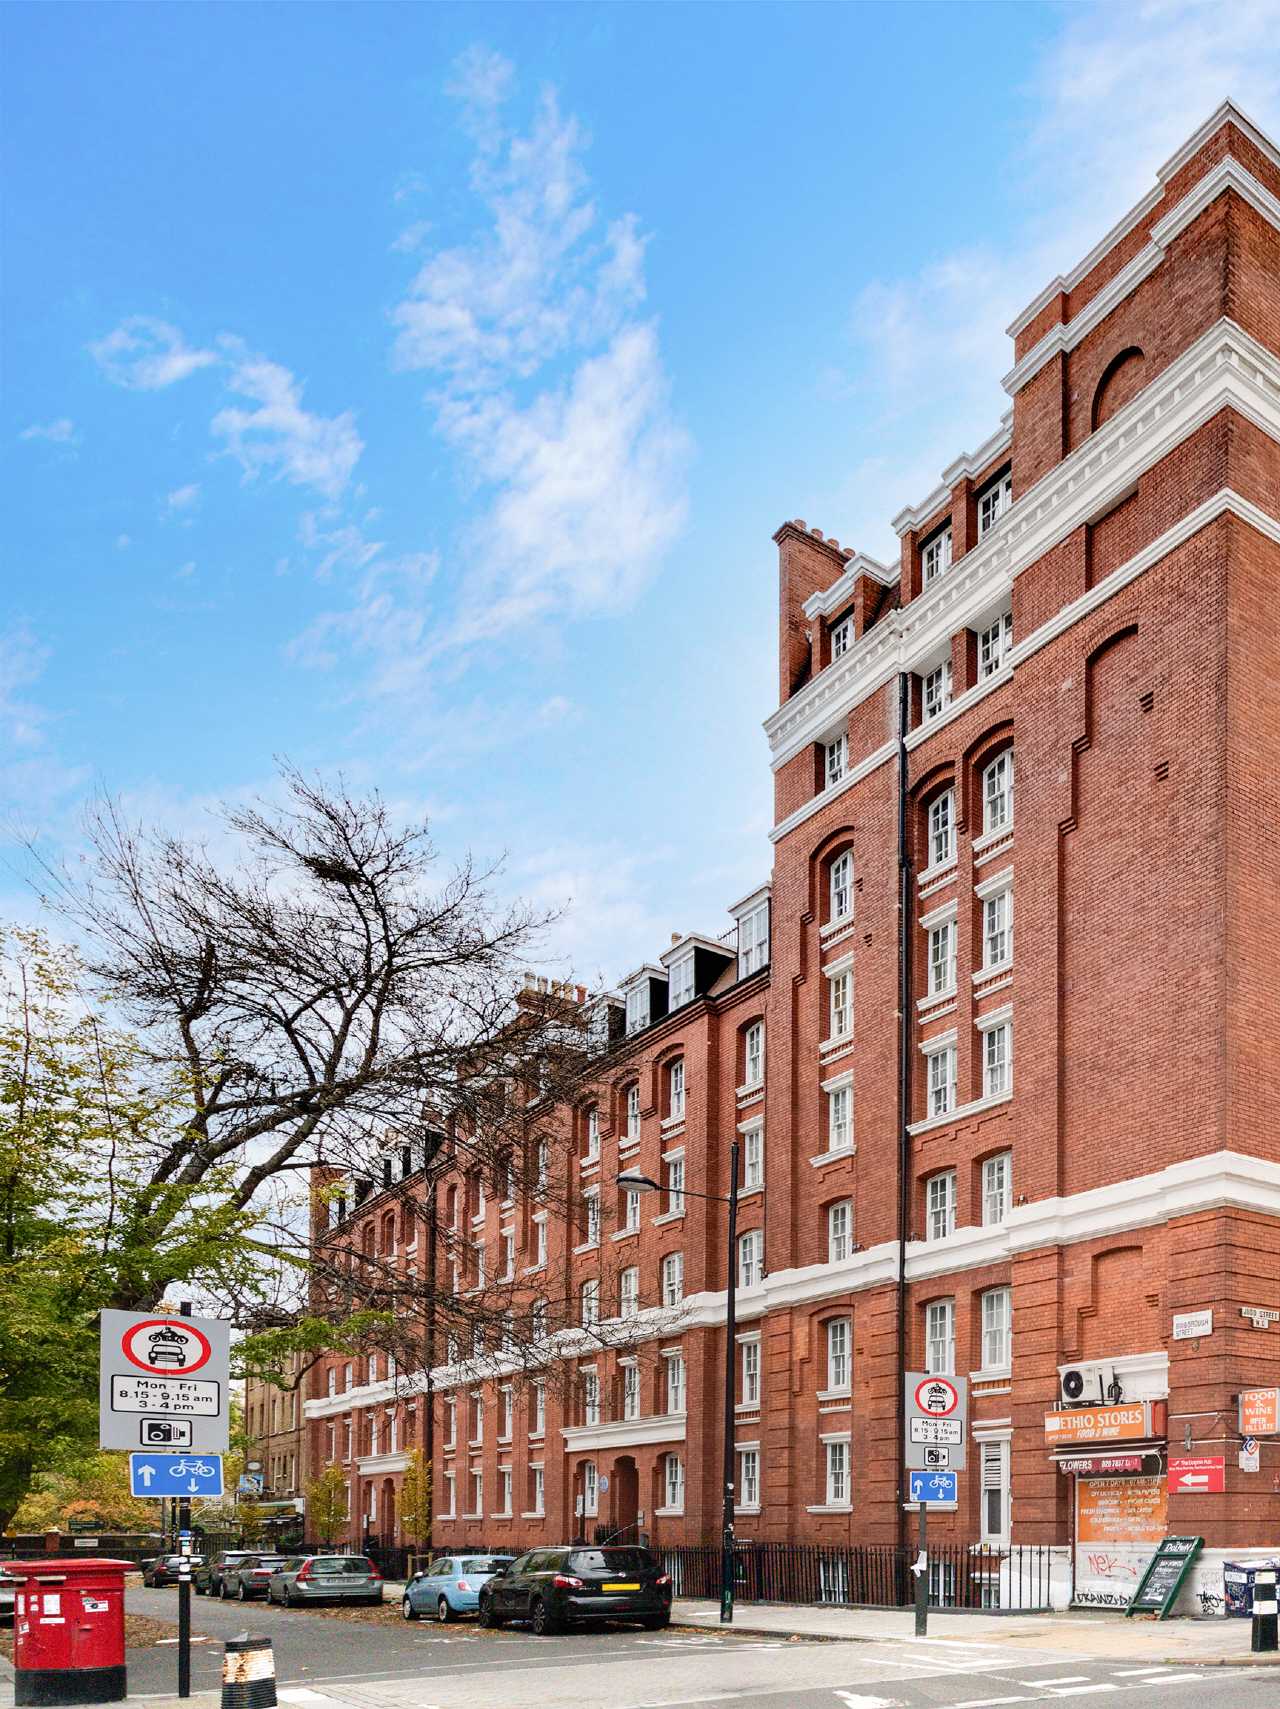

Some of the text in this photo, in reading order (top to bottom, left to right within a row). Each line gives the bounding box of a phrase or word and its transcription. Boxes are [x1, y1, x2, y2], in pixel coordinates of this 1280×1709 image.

[1259, 1310, 1278, 1320] STREET
[1175, 1328, 1193, 1338] STREET
[136, 1380, 167, 1391] Mon
[179, 1383, 198, 1392] Fri
[119, 1390, 150, 1399] 8.15
[160, 1392, 190, 1401] 9.15
[1244, 1391, 1276, 1401] FOOD
[138, 1400, 148, 1409] 3
[173, 1403, 194, 1411] pm
[1244, 1407, 1273, 1416] WINE
[1060, 1409, 1143, 1430] ETHIO STORES
[1060, 1460, 1093, 1471] FLOWERS
